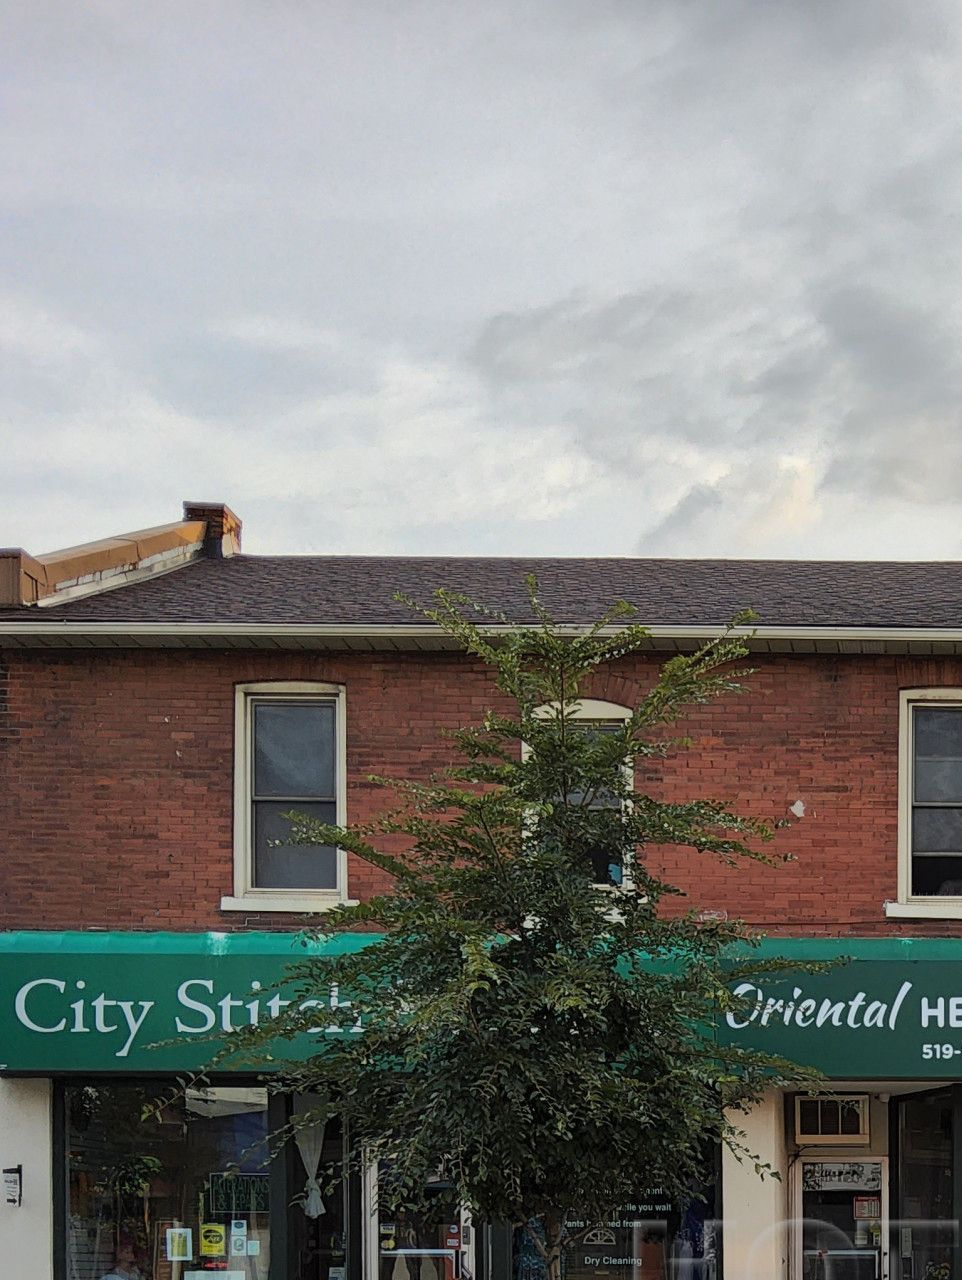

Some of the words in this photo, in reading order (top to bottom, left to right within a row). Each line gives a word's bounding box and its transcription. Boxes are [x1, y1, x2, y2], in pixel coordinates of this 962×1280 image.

[725, 981, 914, 1031] Oriental
[14, 978, 155, 1057] City
[638, 1204, 653, 1213] you
[655, 1203, 671, 1211] wait
[622, 1220, 641, 1228] from
[584, 1257, 600, 1267] Dry
[602, 1257, 642, 1267] Cleaning
